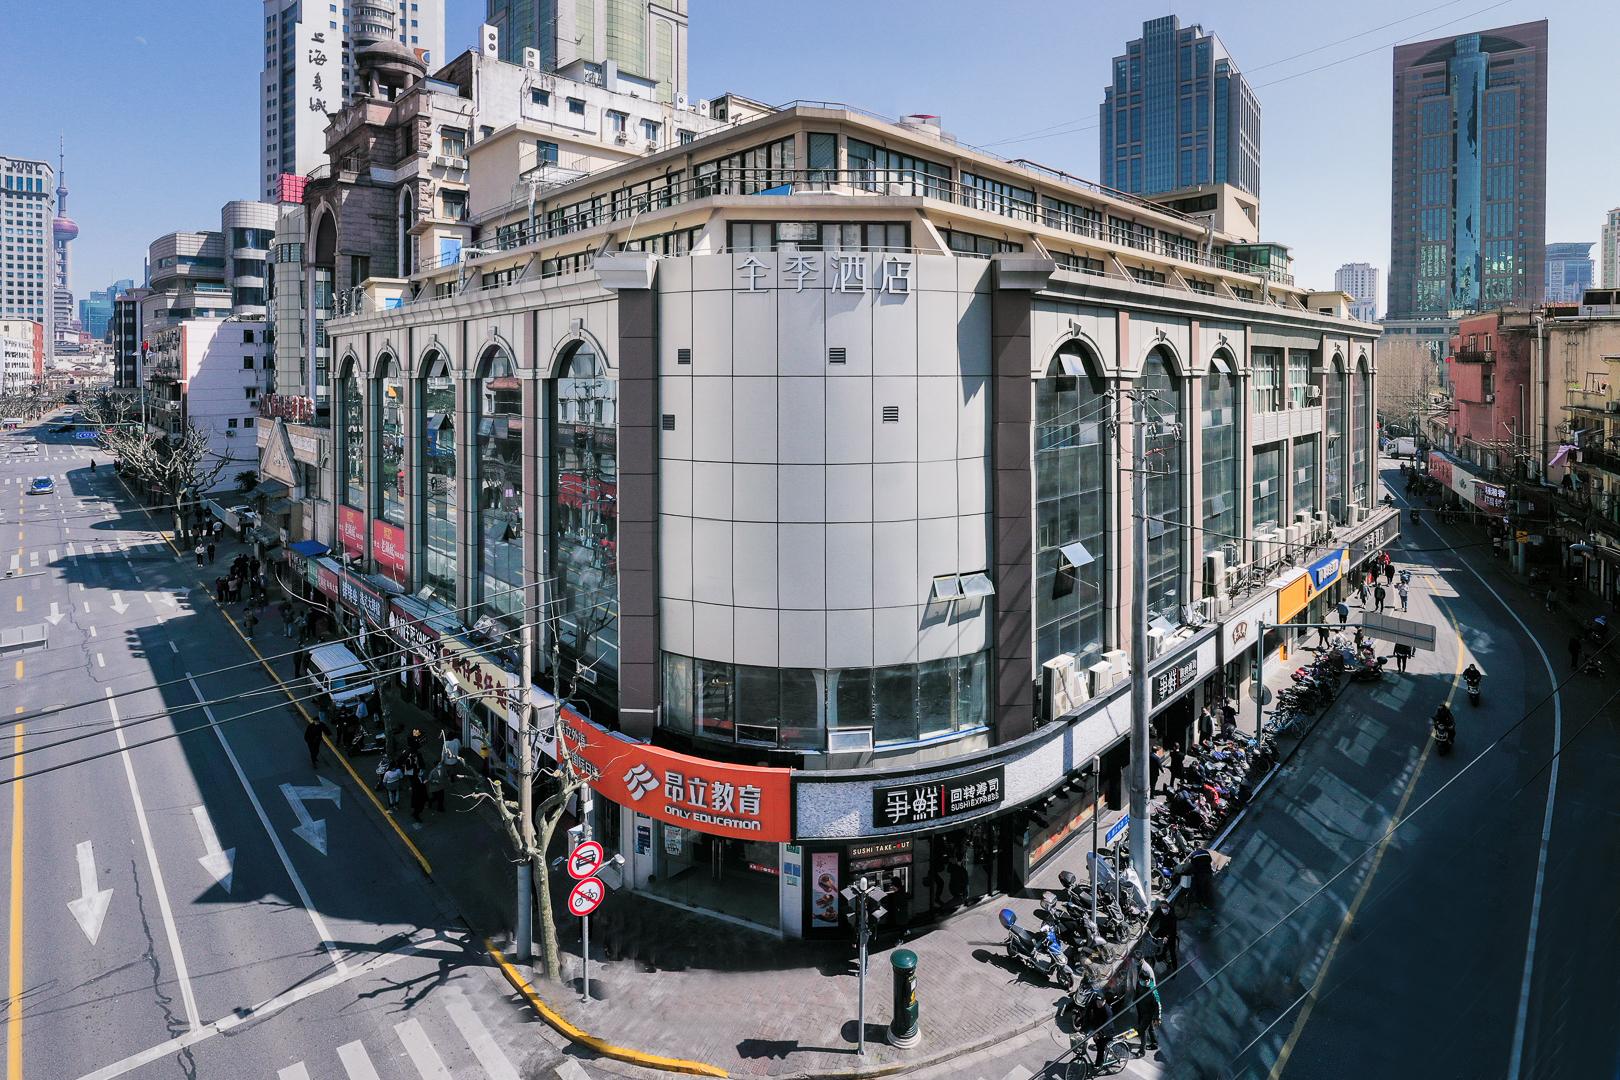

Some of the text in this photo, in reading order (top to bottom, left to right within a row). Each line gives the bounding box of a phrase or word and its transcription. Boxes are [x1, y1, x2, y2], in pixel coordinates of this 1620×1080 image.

[736, 254, 912, 295] 全季酒店
[664, 770, 761, 816] 昂立教育
[950, 777, 999, 804] 回转寿司
[664, 804, 761, 831] ONLY EDUCATION
[852, 847, 873, 856] SUSHI
